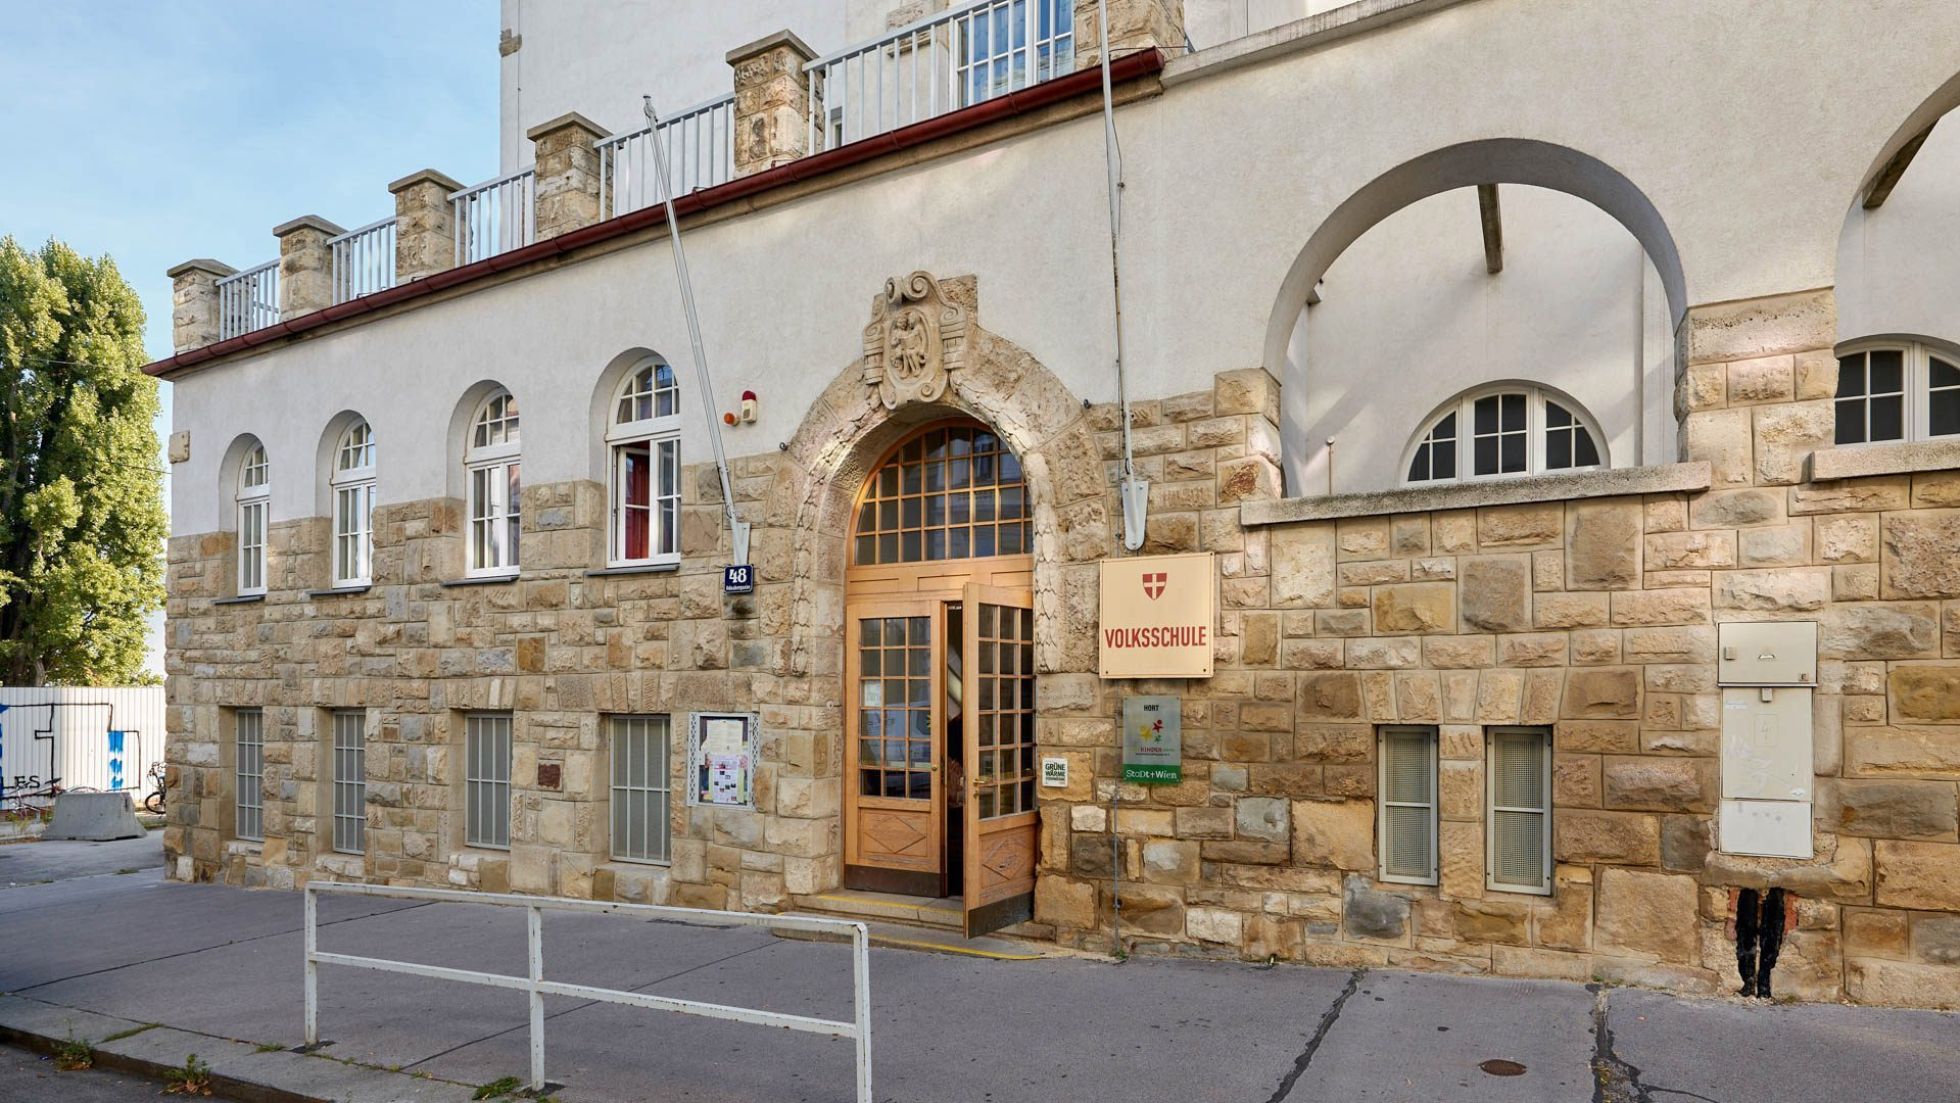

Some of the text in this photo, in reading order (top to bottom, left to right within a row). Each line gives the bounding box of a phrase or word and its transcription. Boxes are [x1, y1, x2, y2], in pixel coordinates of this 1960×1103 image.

[729, 568, 747, 583] 48
[1104, 626, 1207, 648] VOLKSSCHULE
[1143, 704, 1160, 712] HORT
[1045, 762, 1066, 770] GRÜNE
